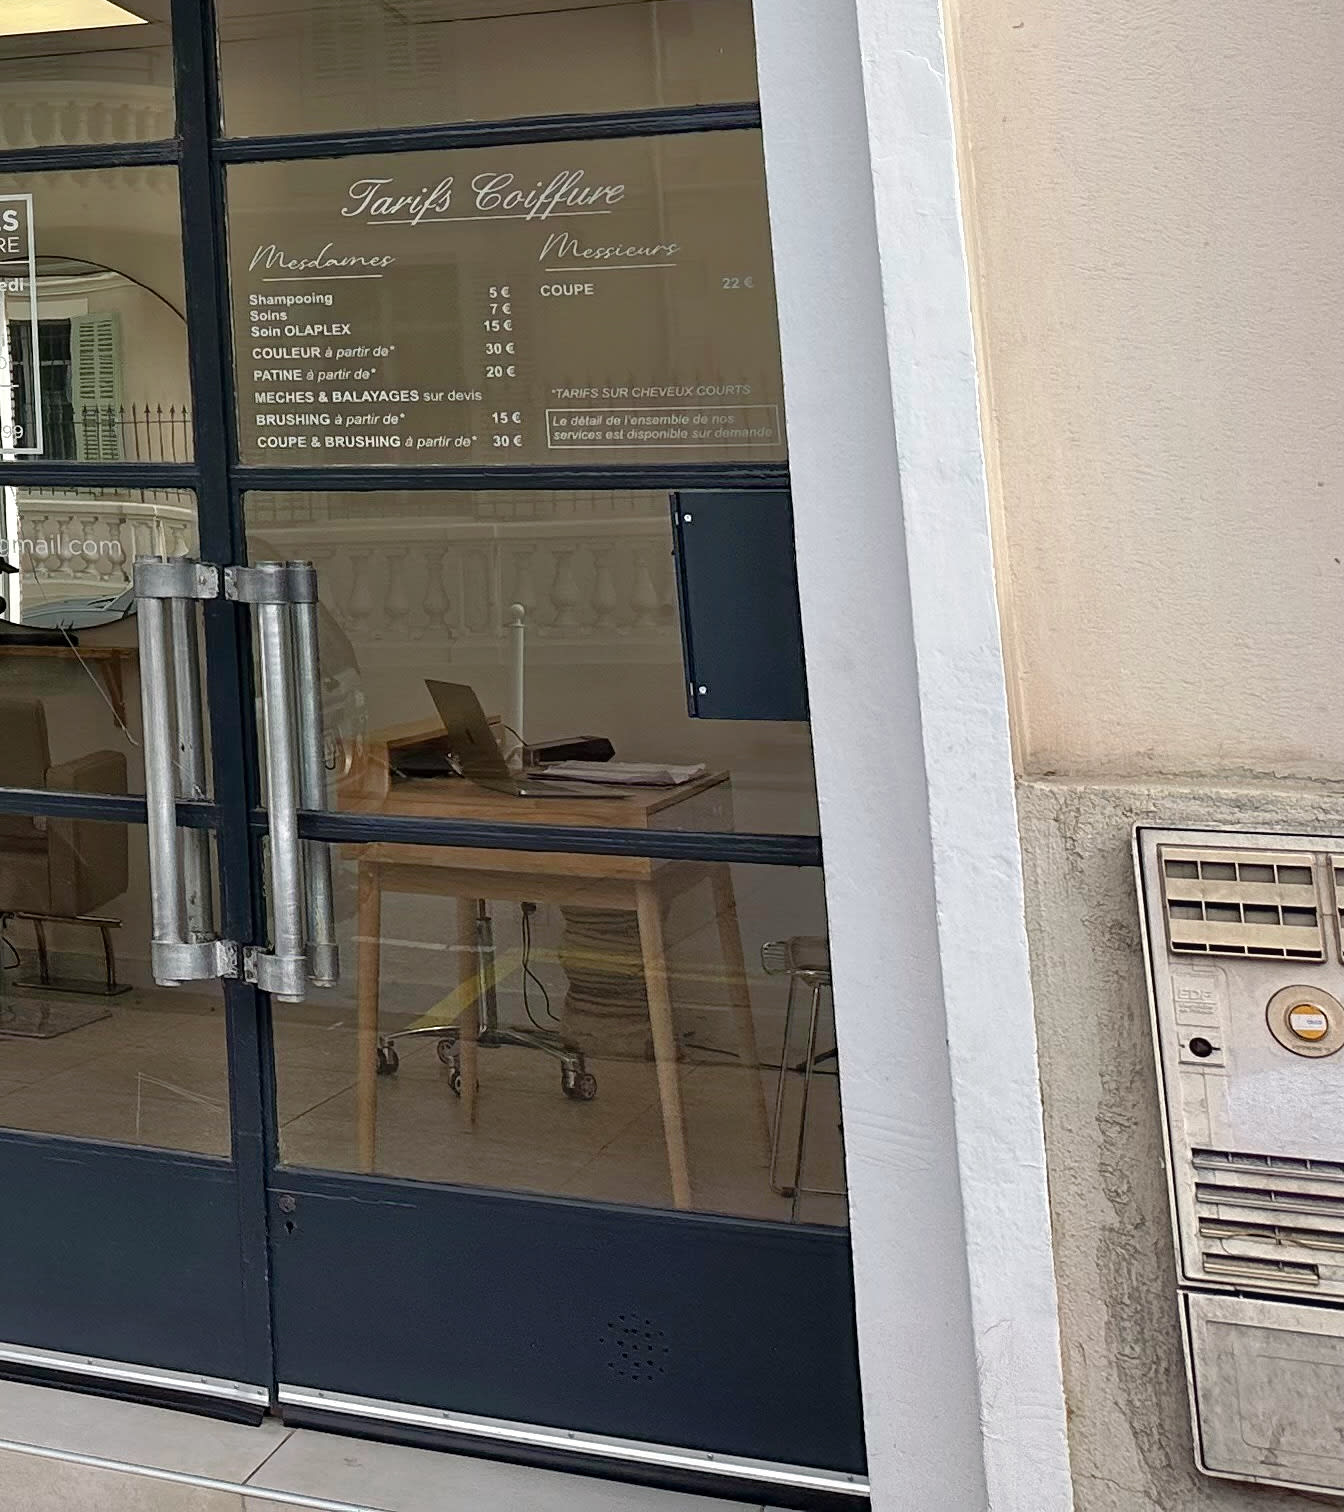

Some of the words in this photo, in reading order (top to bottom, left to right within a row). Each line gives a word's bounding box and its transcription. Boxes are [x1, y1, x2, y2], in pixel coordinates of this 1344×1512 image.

[341, 176, 454, 226] Tarifs
[471, 169, 625, 221] Coiffure
[538, 232, 681, 262] Messieurs
[248, 242, 396, 272] Mesdames
[540, 283, 594, 296] COUPE
[722, 277, 740, 289] 22
[743, 276, 753, 289] €
[249, 292, 333, 307] Shampooing
[489, 287, 498, 298] 5
[501, 286, 510, 298] €
[250, 309, 288, 322] Soins
[489, 303, 497, 315] 7
[502, 303, 511, 315] €
[250, 325, 281, 337] Soin
[284, 323, 351, 336] OLAPLEX
[483, 319, 500, 332] 15
[503, 319, 513, 332] €
[252, 347, 321, 359] COULEUR
[325, 346, 333, 359] à
[336, 345, 370, 360] partir
[485, 343, 502, 355] 30
[505, 342, 515, 355] €
[253, 369, 302, 382] PATINE
[306, 369, 314, 381] à
[317, 368, 351, 383] partir
[485, 366, 503, 378] 20
[506, 365, 516, 378] €
[254, 391, 314, 404] MECHES
[318, 391, 329, 403] &
[332, 389, 419, 403] BALAYAGES
[423, 392, 444, 402] sur
[447, 388, 483, 402] devis
[601, 387, 628, 398] SUR
[631, 386, 694, 398] CHEVEUX
[696, 384, 752, 396] COURTS
[256, 413, 330, 426] BRUSHING
[334, 413, 343, 426] à
[346, 413, 380, 427] partir
[491, 412, 509, 424] 15
[512, 411, 521, 424] €
[552, 416, 567, 427] Le
[570, 415, 603, 427] détail
[605, 415, 621, 426] de
[624, 414, 690, 426] l'ensemble
[692, 414, 709, 425] de
[712, 415, 736, 425] nos
[2, 424, 24, 439] 99
[553, 429, 603, 441] services
[605, 429, 624, 440] est
[627, 427, 689, 442] disponible
[692, 429, 712, 439] sur
[714, 426, 774, 438] demande
[257, 436, 307, 448] COUPE
[310, 435, 321, 448] &
[325, 435, 401, 448] BRUSHING
[404, 435, 413, 448] à
[416, 434, 451, 449] partir
[493, 434, 510, 447] 30
[513, 434, 523, 447] €
